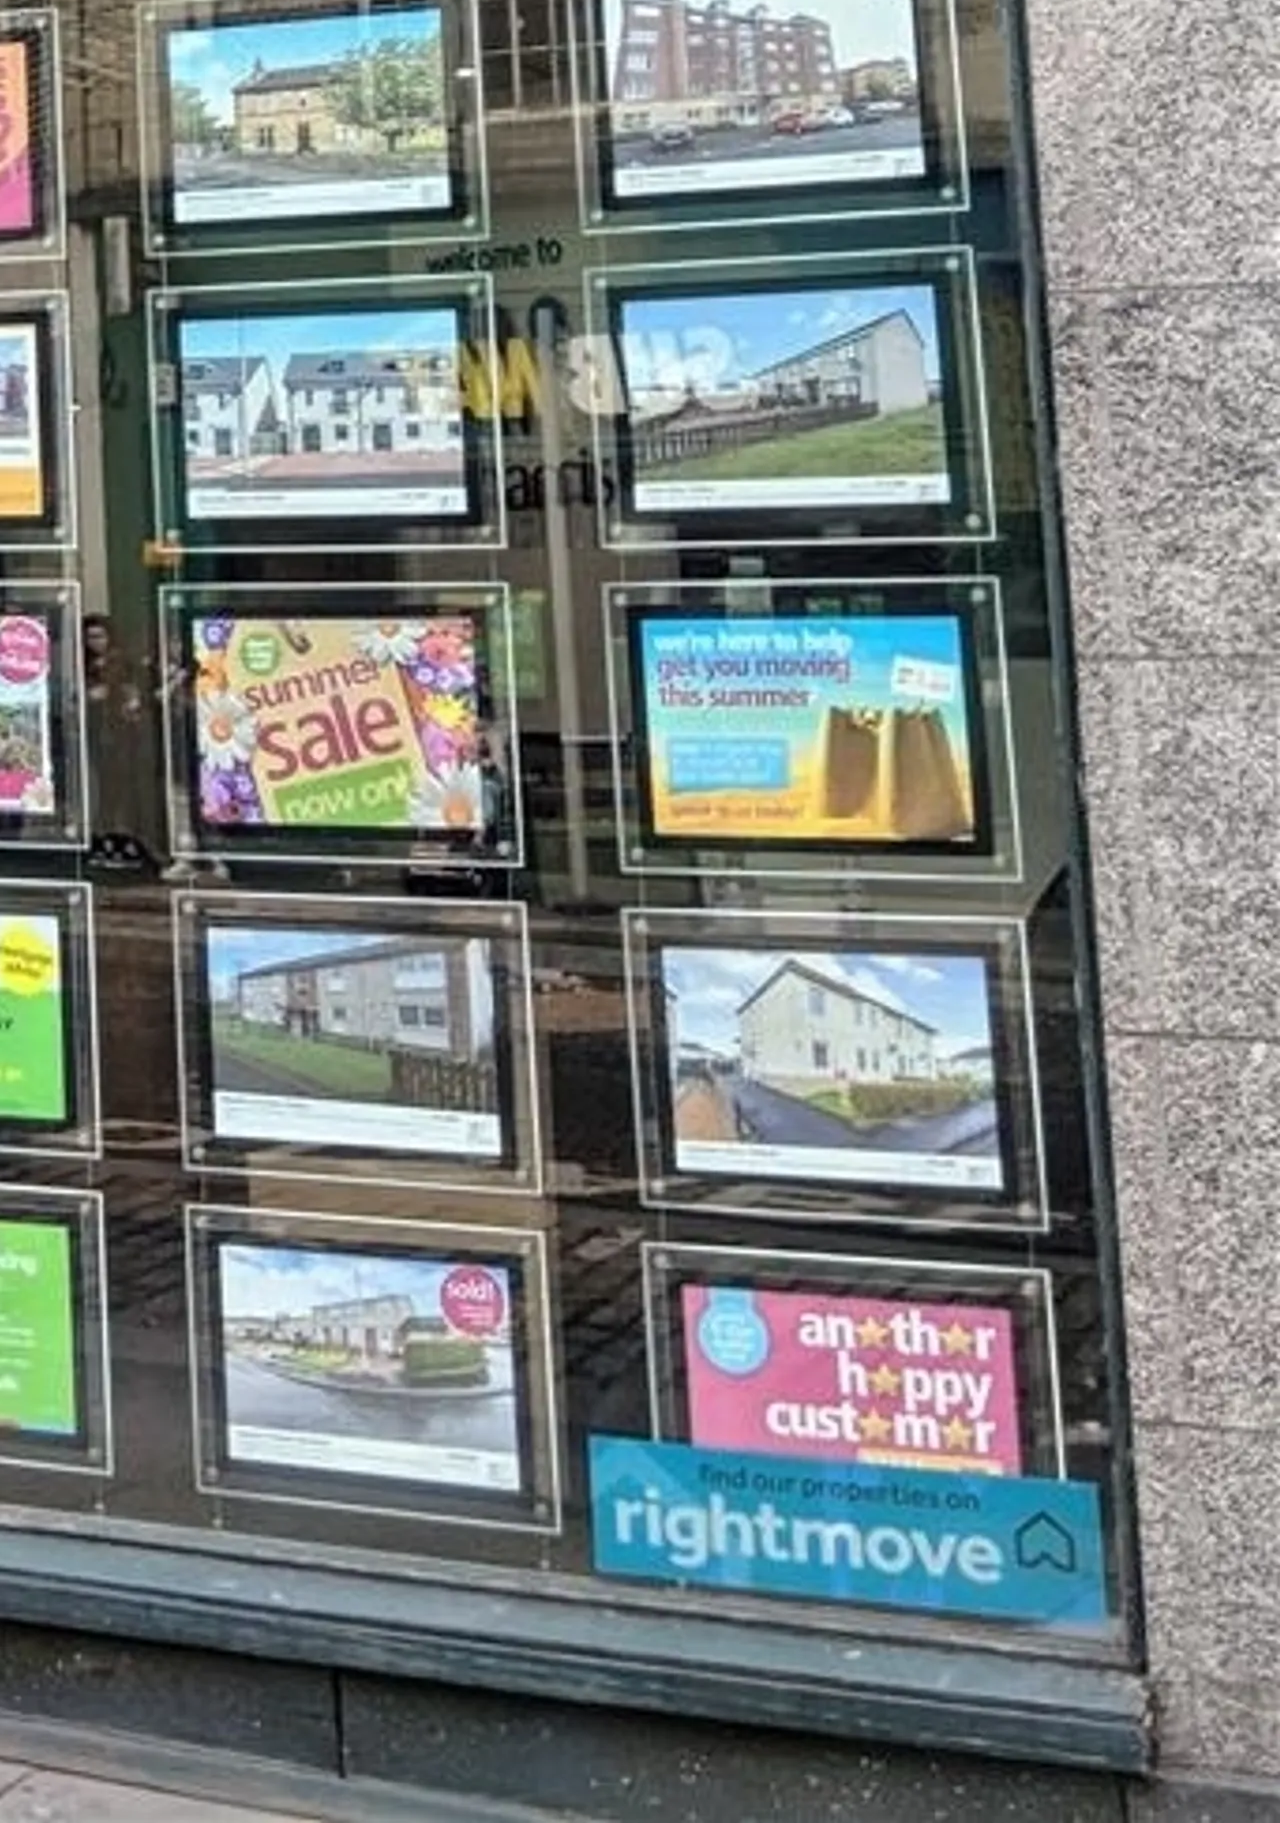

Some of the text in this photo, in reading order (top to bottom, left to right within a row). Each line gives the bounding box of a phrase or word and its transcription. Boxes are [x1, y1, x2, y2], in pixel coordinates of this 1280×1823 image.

[537, 238, 562, 265] to
[801, 626, 853, 654] help
[244, 656, 381, 710] summer
[657, 652, 852, 682] get you moving
[658, 684, 811, 708] this summer
[256, 695, 403, 783] sale
[284, 787, 357, 821] now
[700, 1462, 980, 1512] find our properties on
[614, 1488, 1004, 1584] rightmove
